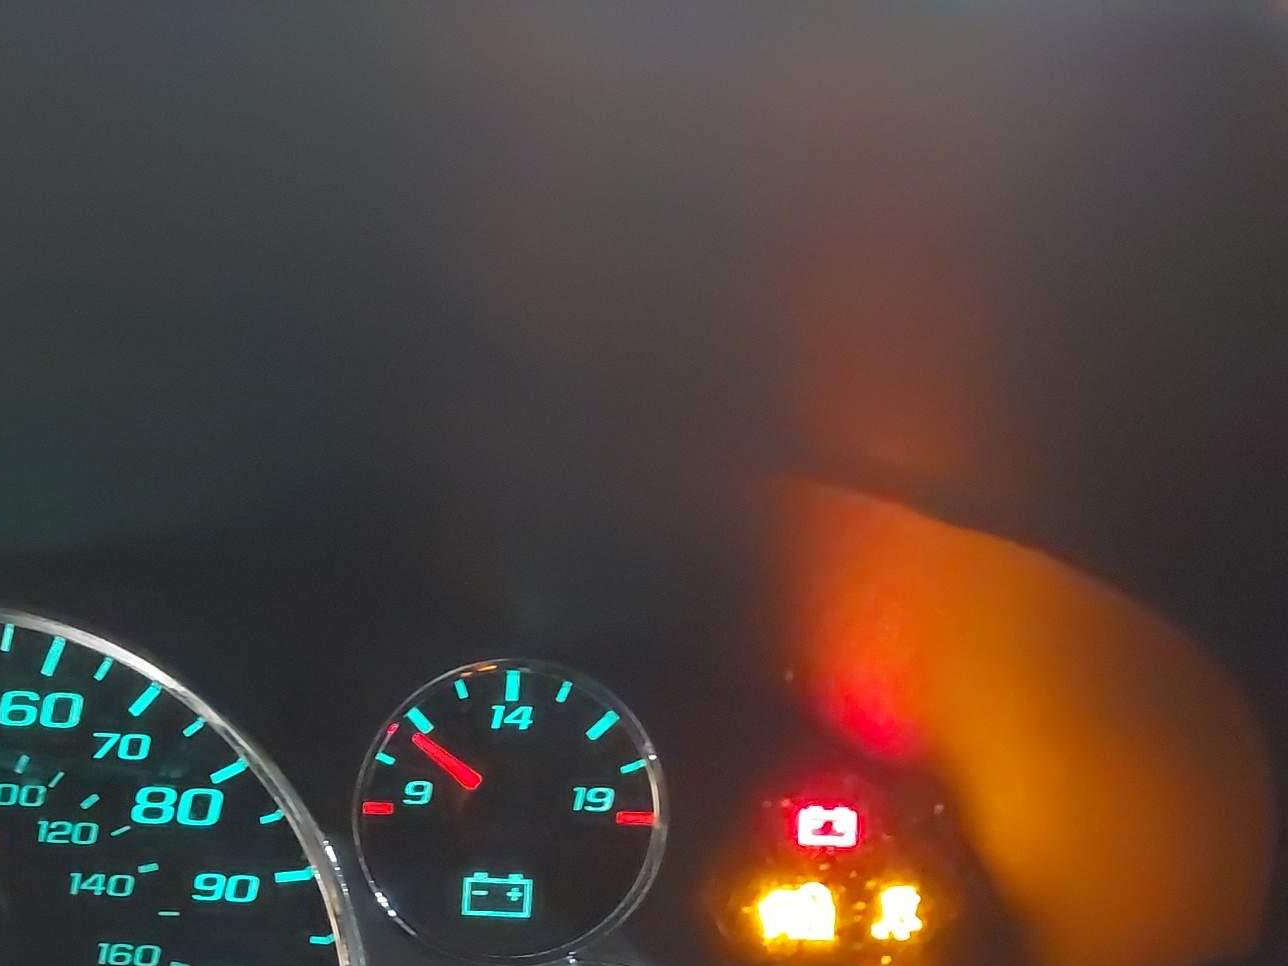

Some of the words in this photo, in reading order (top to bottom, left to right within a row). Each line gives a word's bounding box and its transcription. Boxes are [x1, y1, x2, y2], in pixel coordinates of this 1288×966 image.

[489, 705, 534, 730] 14
[92, 733, 151, 760] 70
[402, 780, 433, 805] 9
[572, 786, 615, 811] 19
[131, 787, 224, 826] 80
[37, 820, 99, 845] 120
[69, 872, 135, 897] 140
[191, 873, 259, 902] 90
[97, 943, 161, 966] 160
